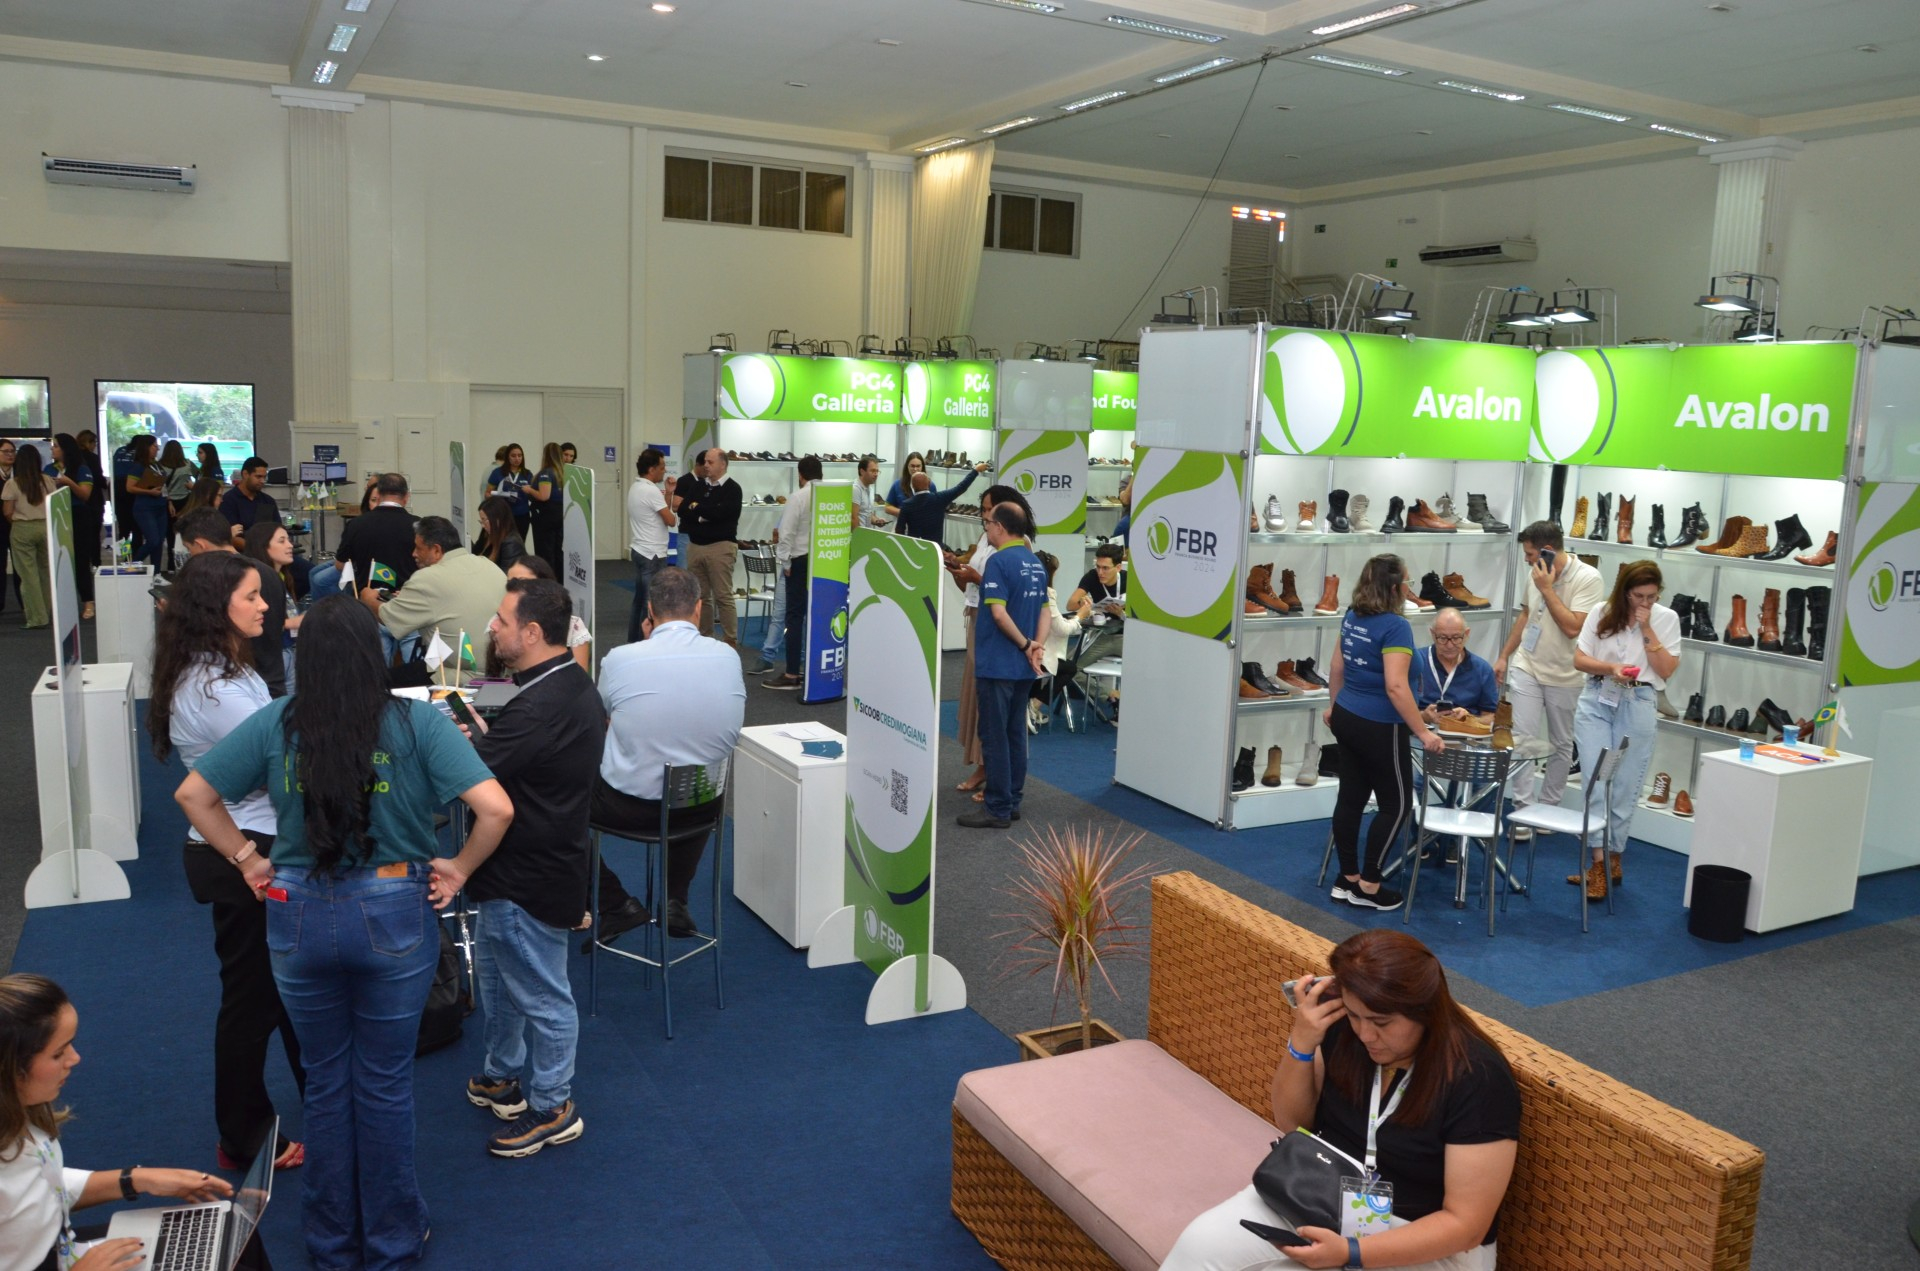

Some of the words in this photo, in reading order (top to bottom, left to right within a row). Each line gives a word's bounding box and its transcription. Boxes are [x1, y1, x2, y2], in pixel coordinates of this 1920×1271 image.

[851, 372, 895, 391] PG4
[964, 374, 990, 392] PG4
[812, 393, 894, 413] Galleria
[944, 396, 989, 417] Galleria
[1112, 395, 1137, 409] Fou
[1412, 385, 1522, 422] Avalon
[1673, 393, 1830, 432] Avalon
[1039, 474, 1072, 489] FBR
[819, 502, 846, 511] BONS
[1176, 527, 1217, 557] FBR
[818, 550, 842, 560] AQUI
[1193, 561, 1215, 573] 2024
[821, 644, 846, 670] FB
[880, 921, 904, 958] FBR
